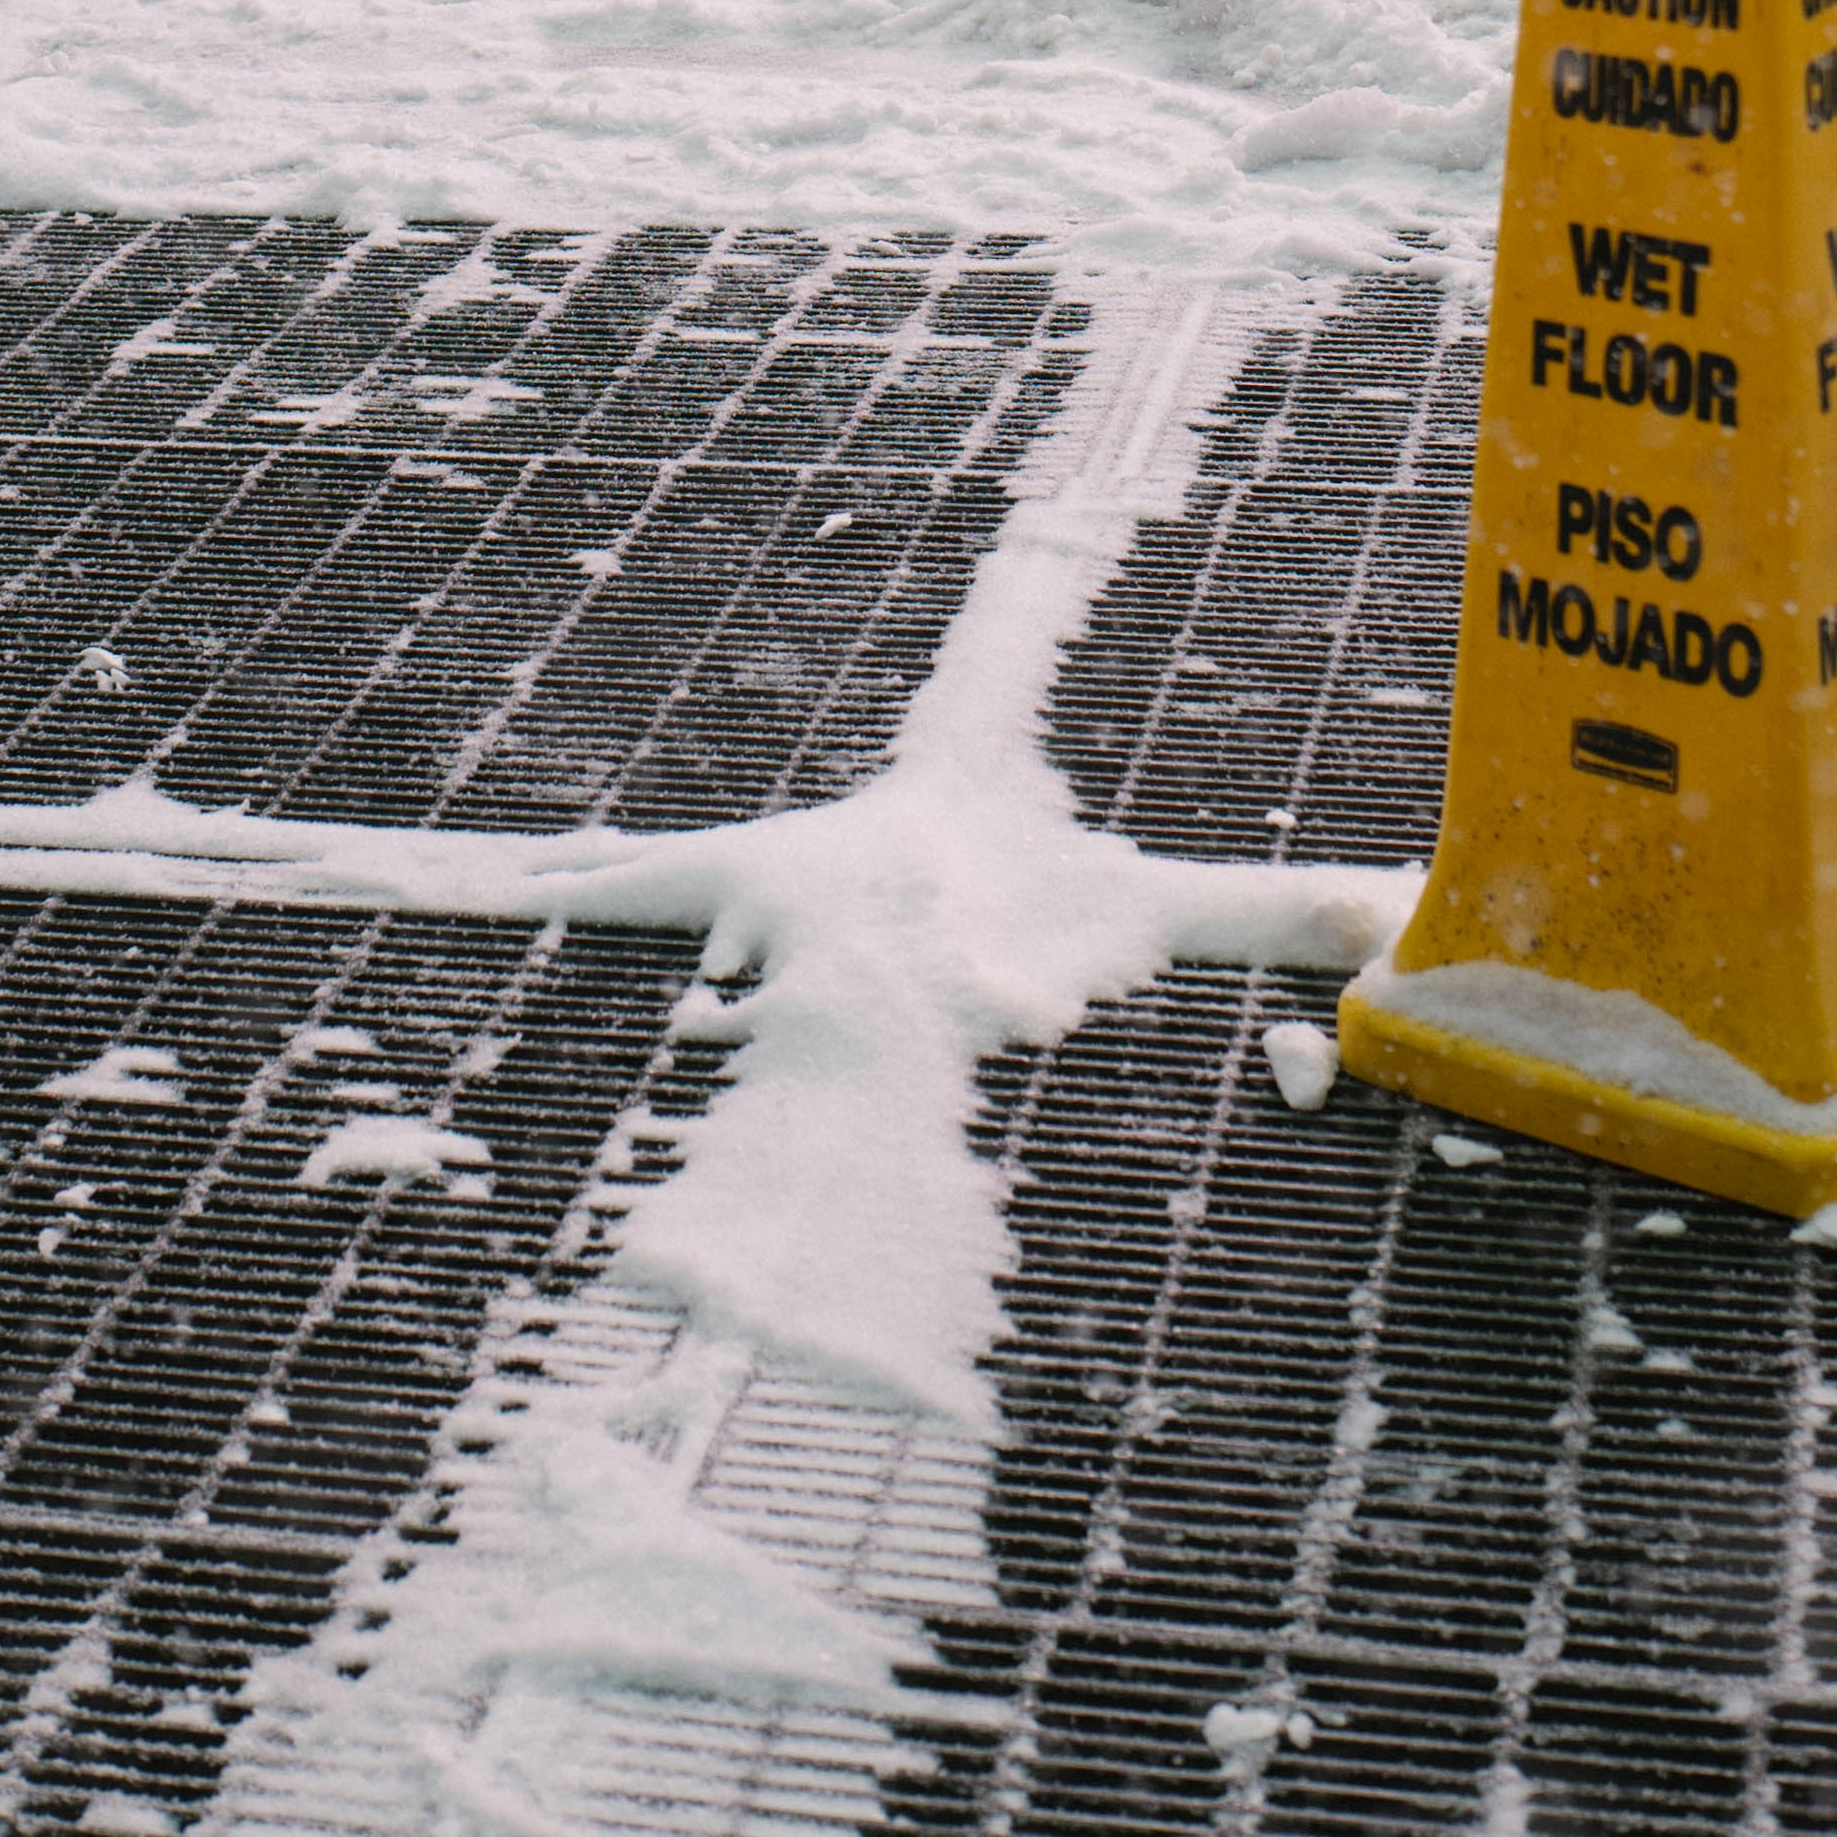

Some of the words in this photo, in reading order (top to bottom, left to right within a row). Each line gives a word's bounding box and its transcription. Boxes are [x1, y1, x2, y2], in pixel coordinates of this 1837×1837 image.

[1553, 48, 1741, 143] CUIDADO
[1568, 222, 1711, 317] WET
[1530, 318, 1739, 430] FLOOR
[1556, 482, 1703, 584] PISO
[1496, 570, 1764, 699] MOJADO
